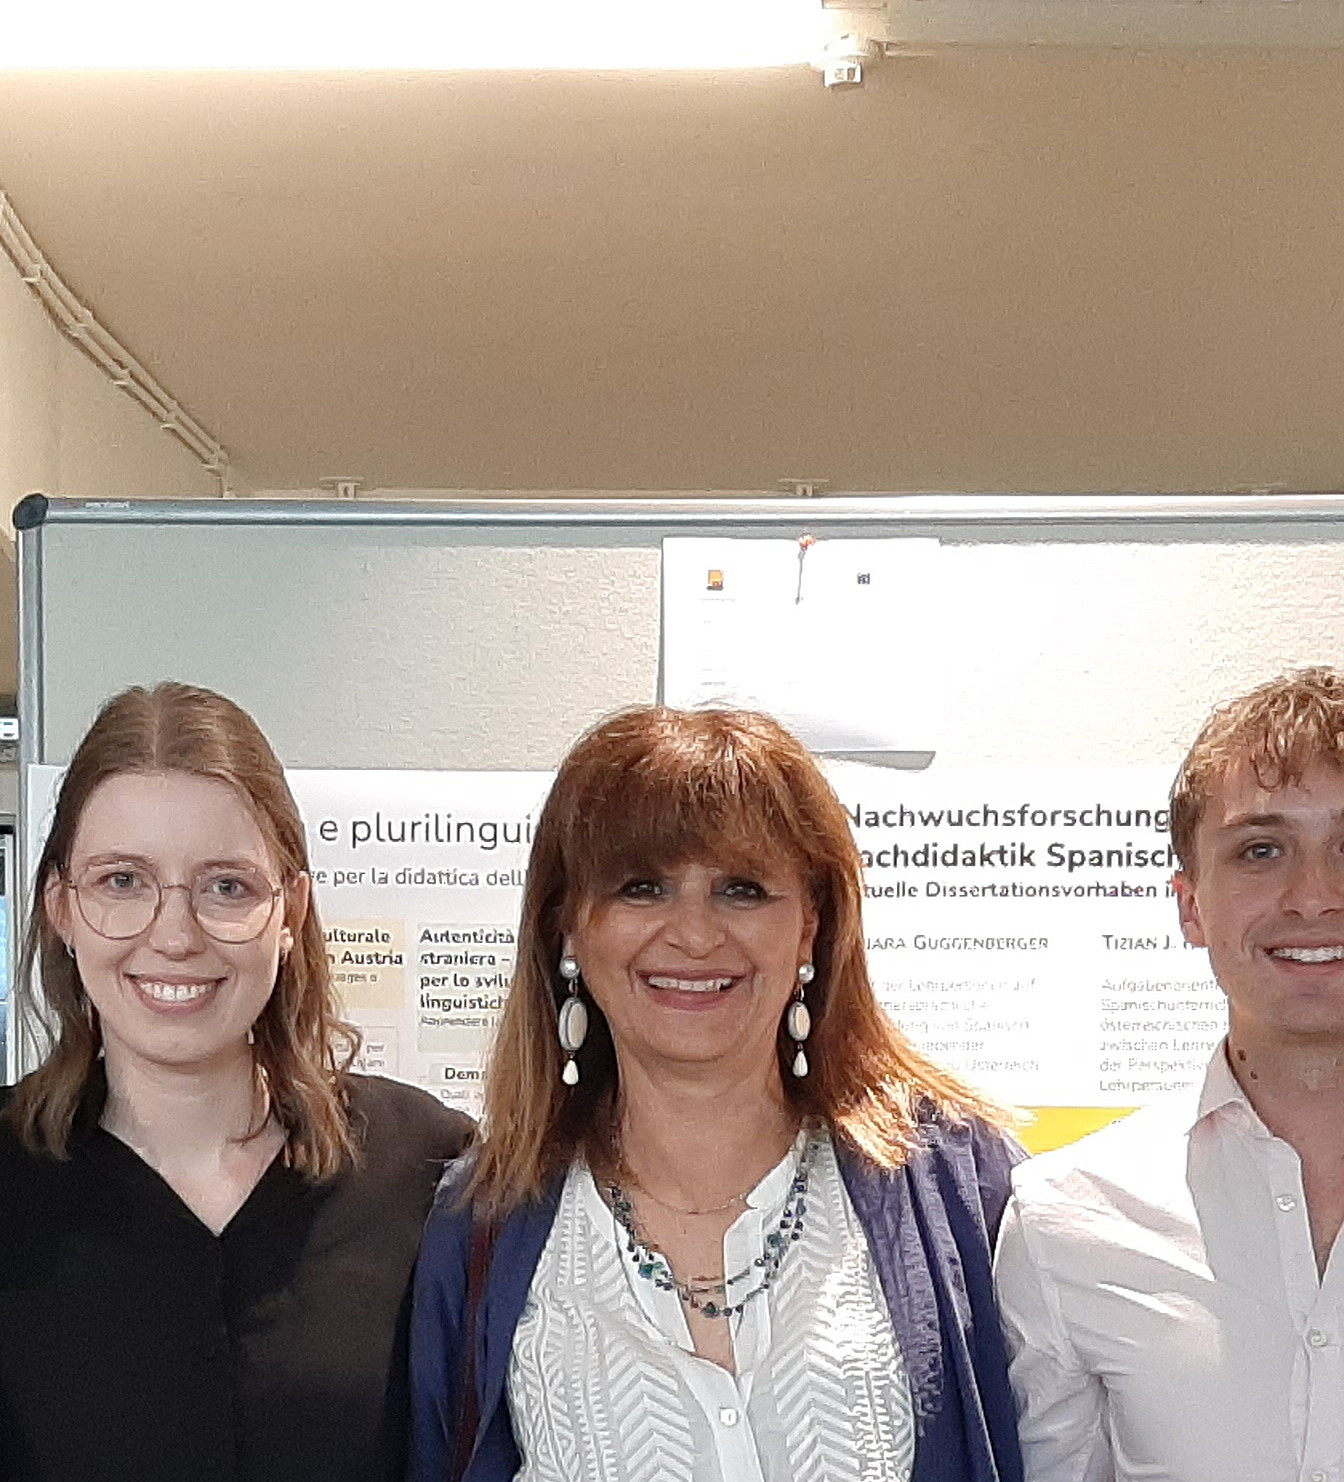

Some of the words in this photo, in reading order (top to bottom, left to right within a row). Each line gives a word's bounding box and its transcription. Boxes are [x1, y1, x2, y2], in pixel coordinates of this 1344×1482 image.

[319, 819, 338, 841] e
[334, 870, 366, 887] per
[372, 868, 388, 884] la
[395, 867, 479, 886] didattica
[926, 881, 1156, 898] Dissertationsvorhaben
[341, 950, 403, 966] Austria
[420, 975, 448, 989] per
[453, 974, 469, 986] lo
